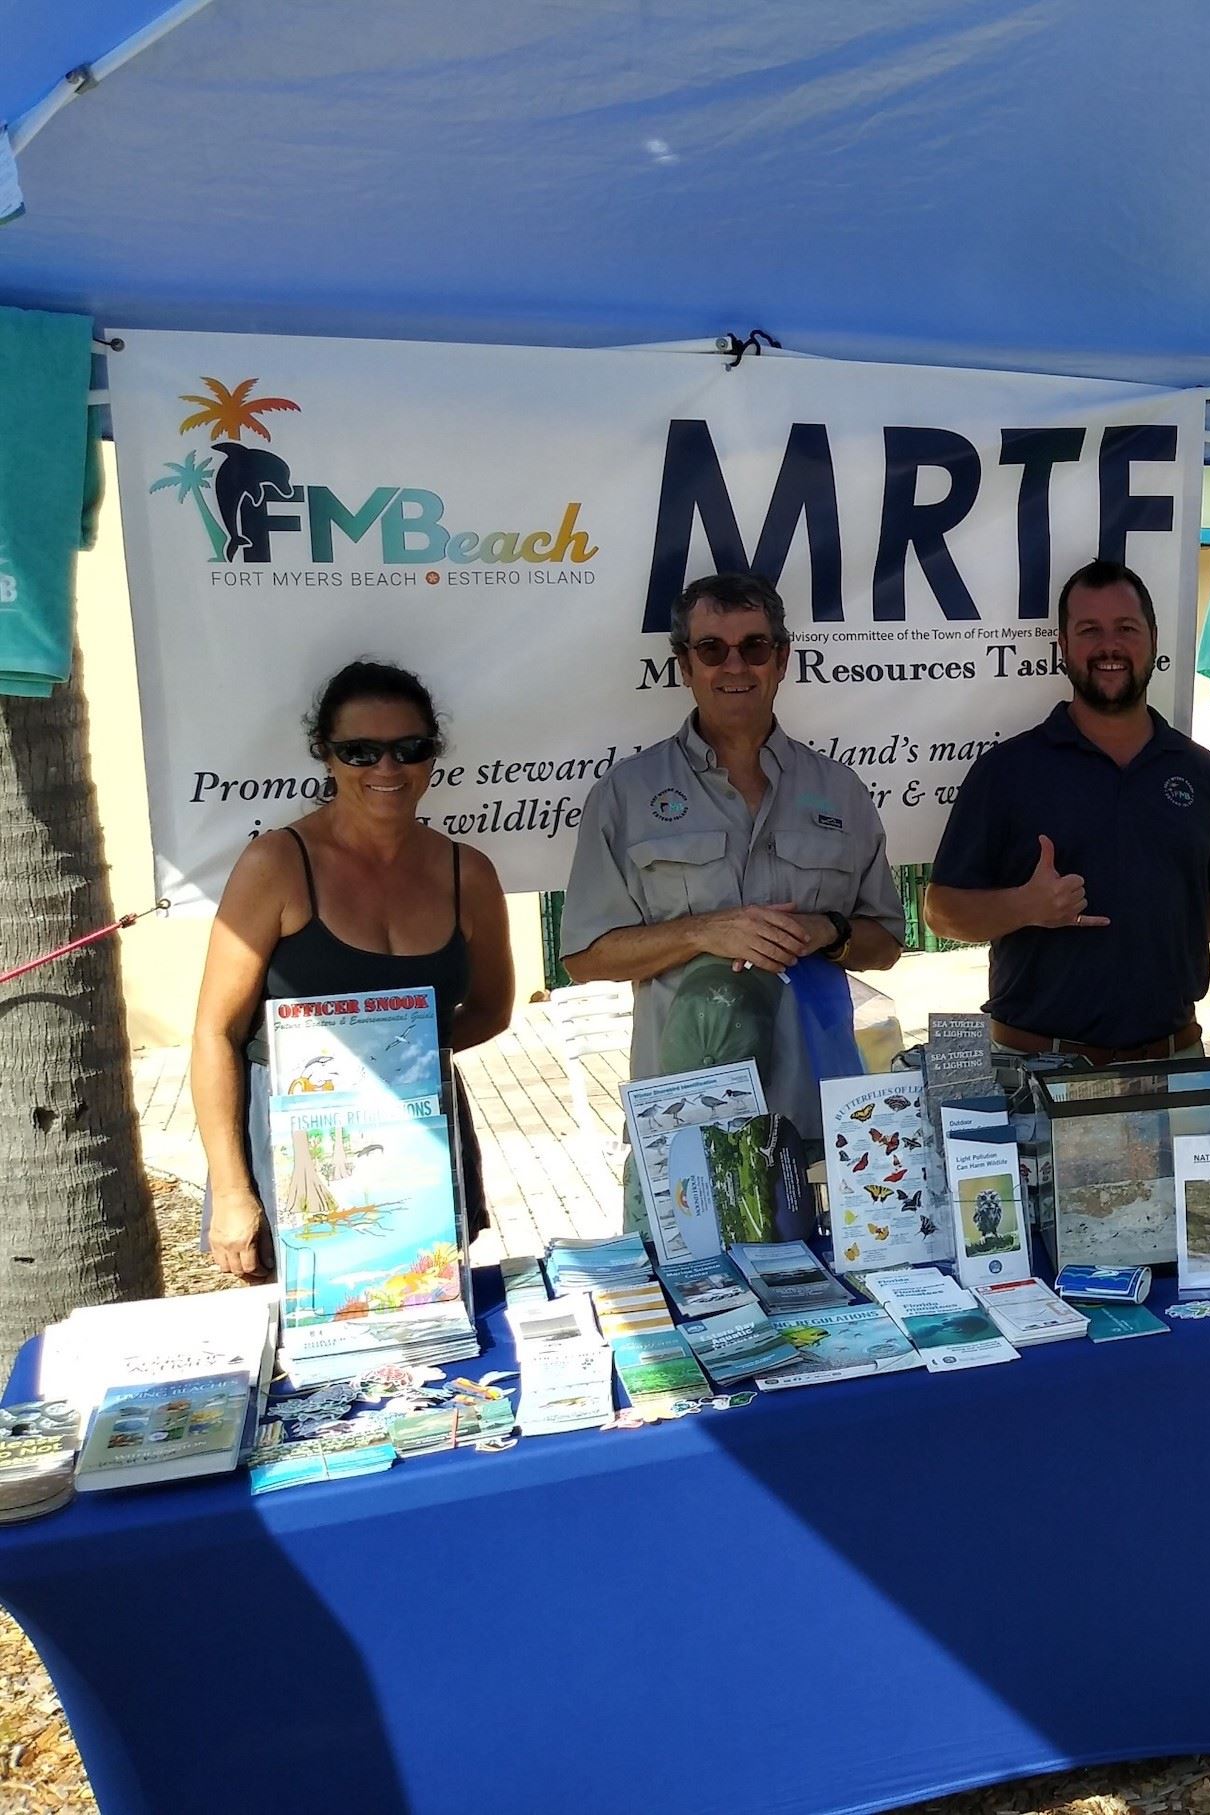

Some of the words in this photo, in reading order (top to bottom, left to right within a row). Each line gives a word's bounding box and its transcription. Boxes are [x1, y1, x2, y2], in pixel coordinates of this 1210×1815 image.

[641, 420, 1178, 634] MRTF
[211, 571, 264, 587] FORT
[272, 571, 342, 587] MYERS
[351, 571, 417, 587] BEACH
[447, 570, 520, 586] ESTERO
[527, 570, 596, 586] ISLAND
[788, 631, 829, 644] dvisory
[832, 630, 894, 642] committee
[896, 629, 908, 640] of
[909, 629, 930, 640] the
[931, 629, 961, 640] Town
[963, 628, 976, 639] of
[977, 628, 999, 639] Fort
[1001, 627, 1033, 642] Myers
[1034, 627, 1059, 638] Beac
[794, 648, 976, 685] Resources
[902, 780, 926, 808] &
[278, 999, 361, 1019] OFFICER
[364, 994, 429, 1013] SNOOK
[932, 1020, 947, 1028] SEA
[950, 1020, 985, 1028] TURTLES
[943, 1030, 983, 1038] LIGHTING
[931, 1052, 946, 1061] SEA
[949, 1050, 984, 1060] TURTLES
[934, 1063, 942, 1071] &
[942, 1059, 983, 1070] LIGHTING
[835, 1087, 893, 1121] BUTTERFLIES
[894, 1086, 907, 1094] OF
[949, 1119, 973, 1127] Outdoor
[956, 1154, 971, 1164] Light
[972, 1151, 998, 1162] Pollution
[956, 1163, 968, 1171] Can
[970, 1161, 985, 1169] Harm
[986, 1158, 1008, 1167] Wildlife
[798, 1310, 879, 1328] REGULATIONS
